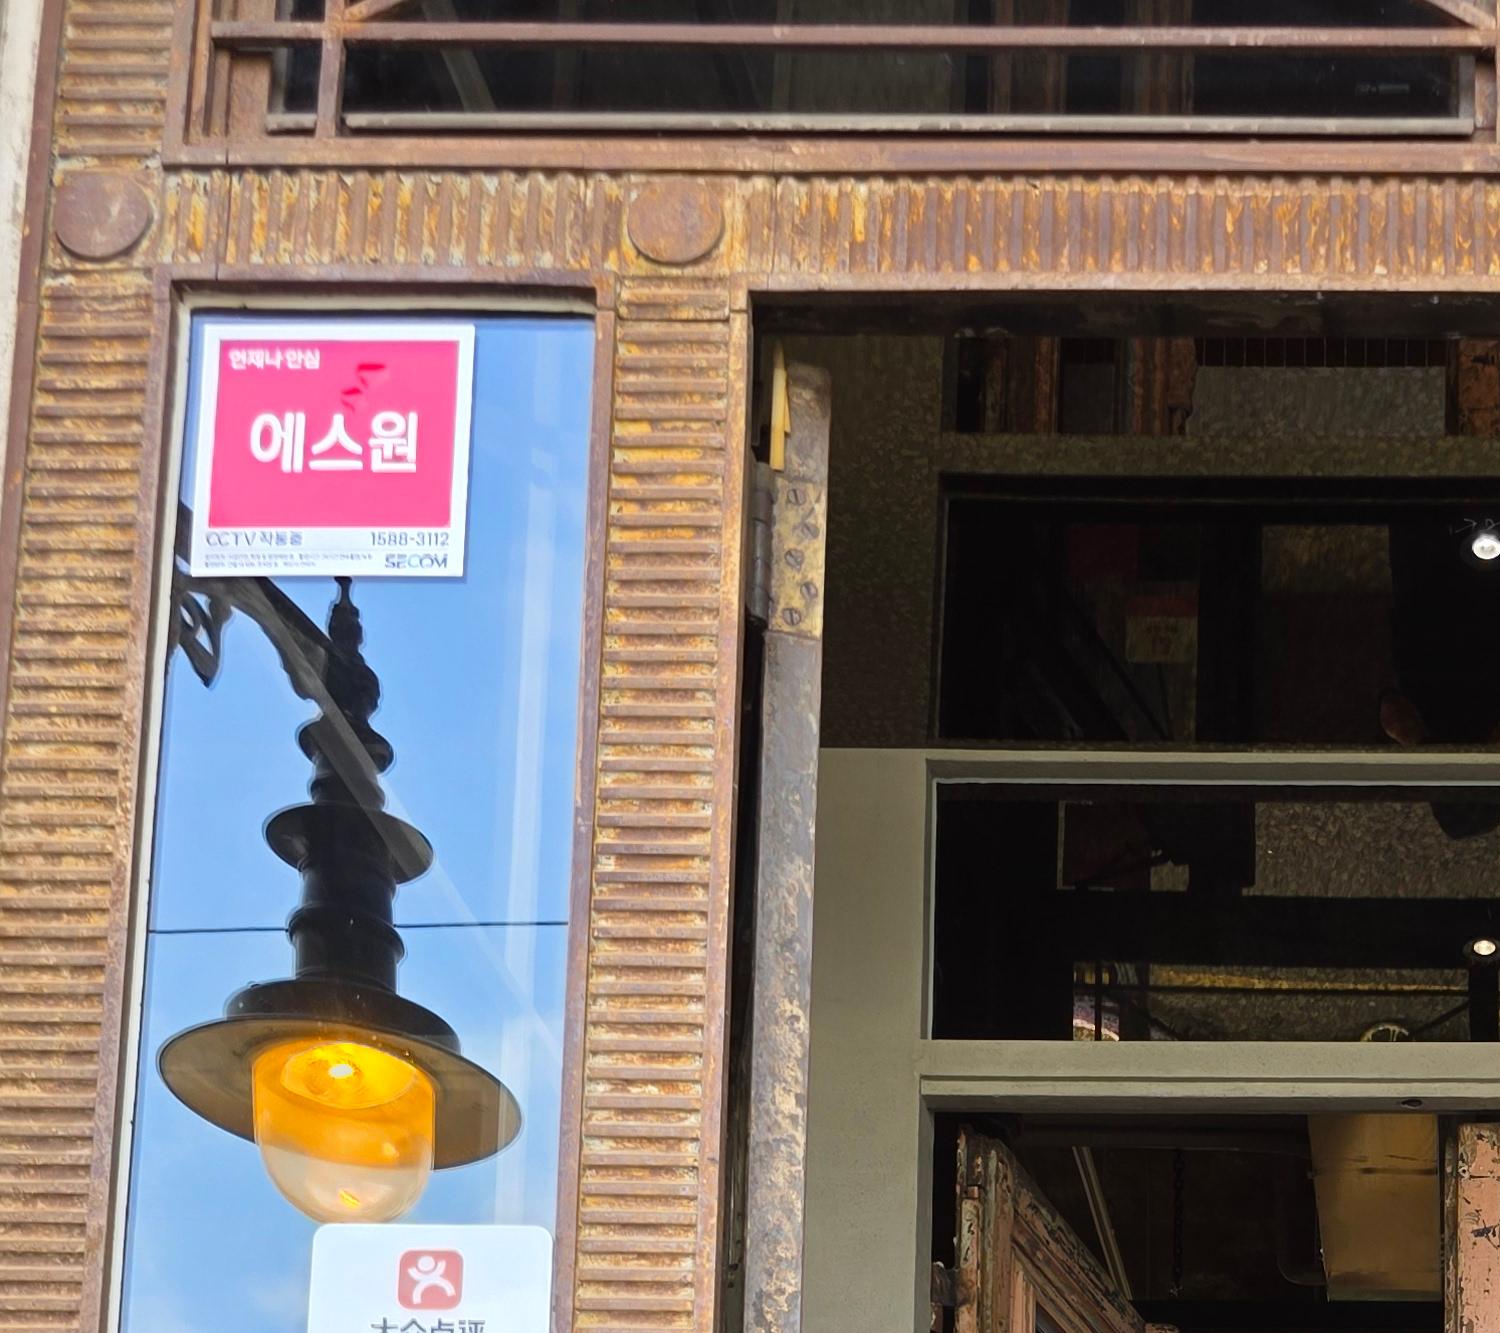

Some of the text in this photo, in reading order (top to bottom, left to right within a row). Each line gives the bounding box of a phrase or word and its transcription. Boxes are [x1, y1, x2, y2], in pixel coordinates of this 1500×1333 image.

[228, 348, 321, 370] 언제나 안심
[249, 410, 419, 474] 에스원
[205, 531, 257, 546] CCTV
[370, 531, 450, 547] 1588-3112
[384, 553, 449, 569] SECOM
